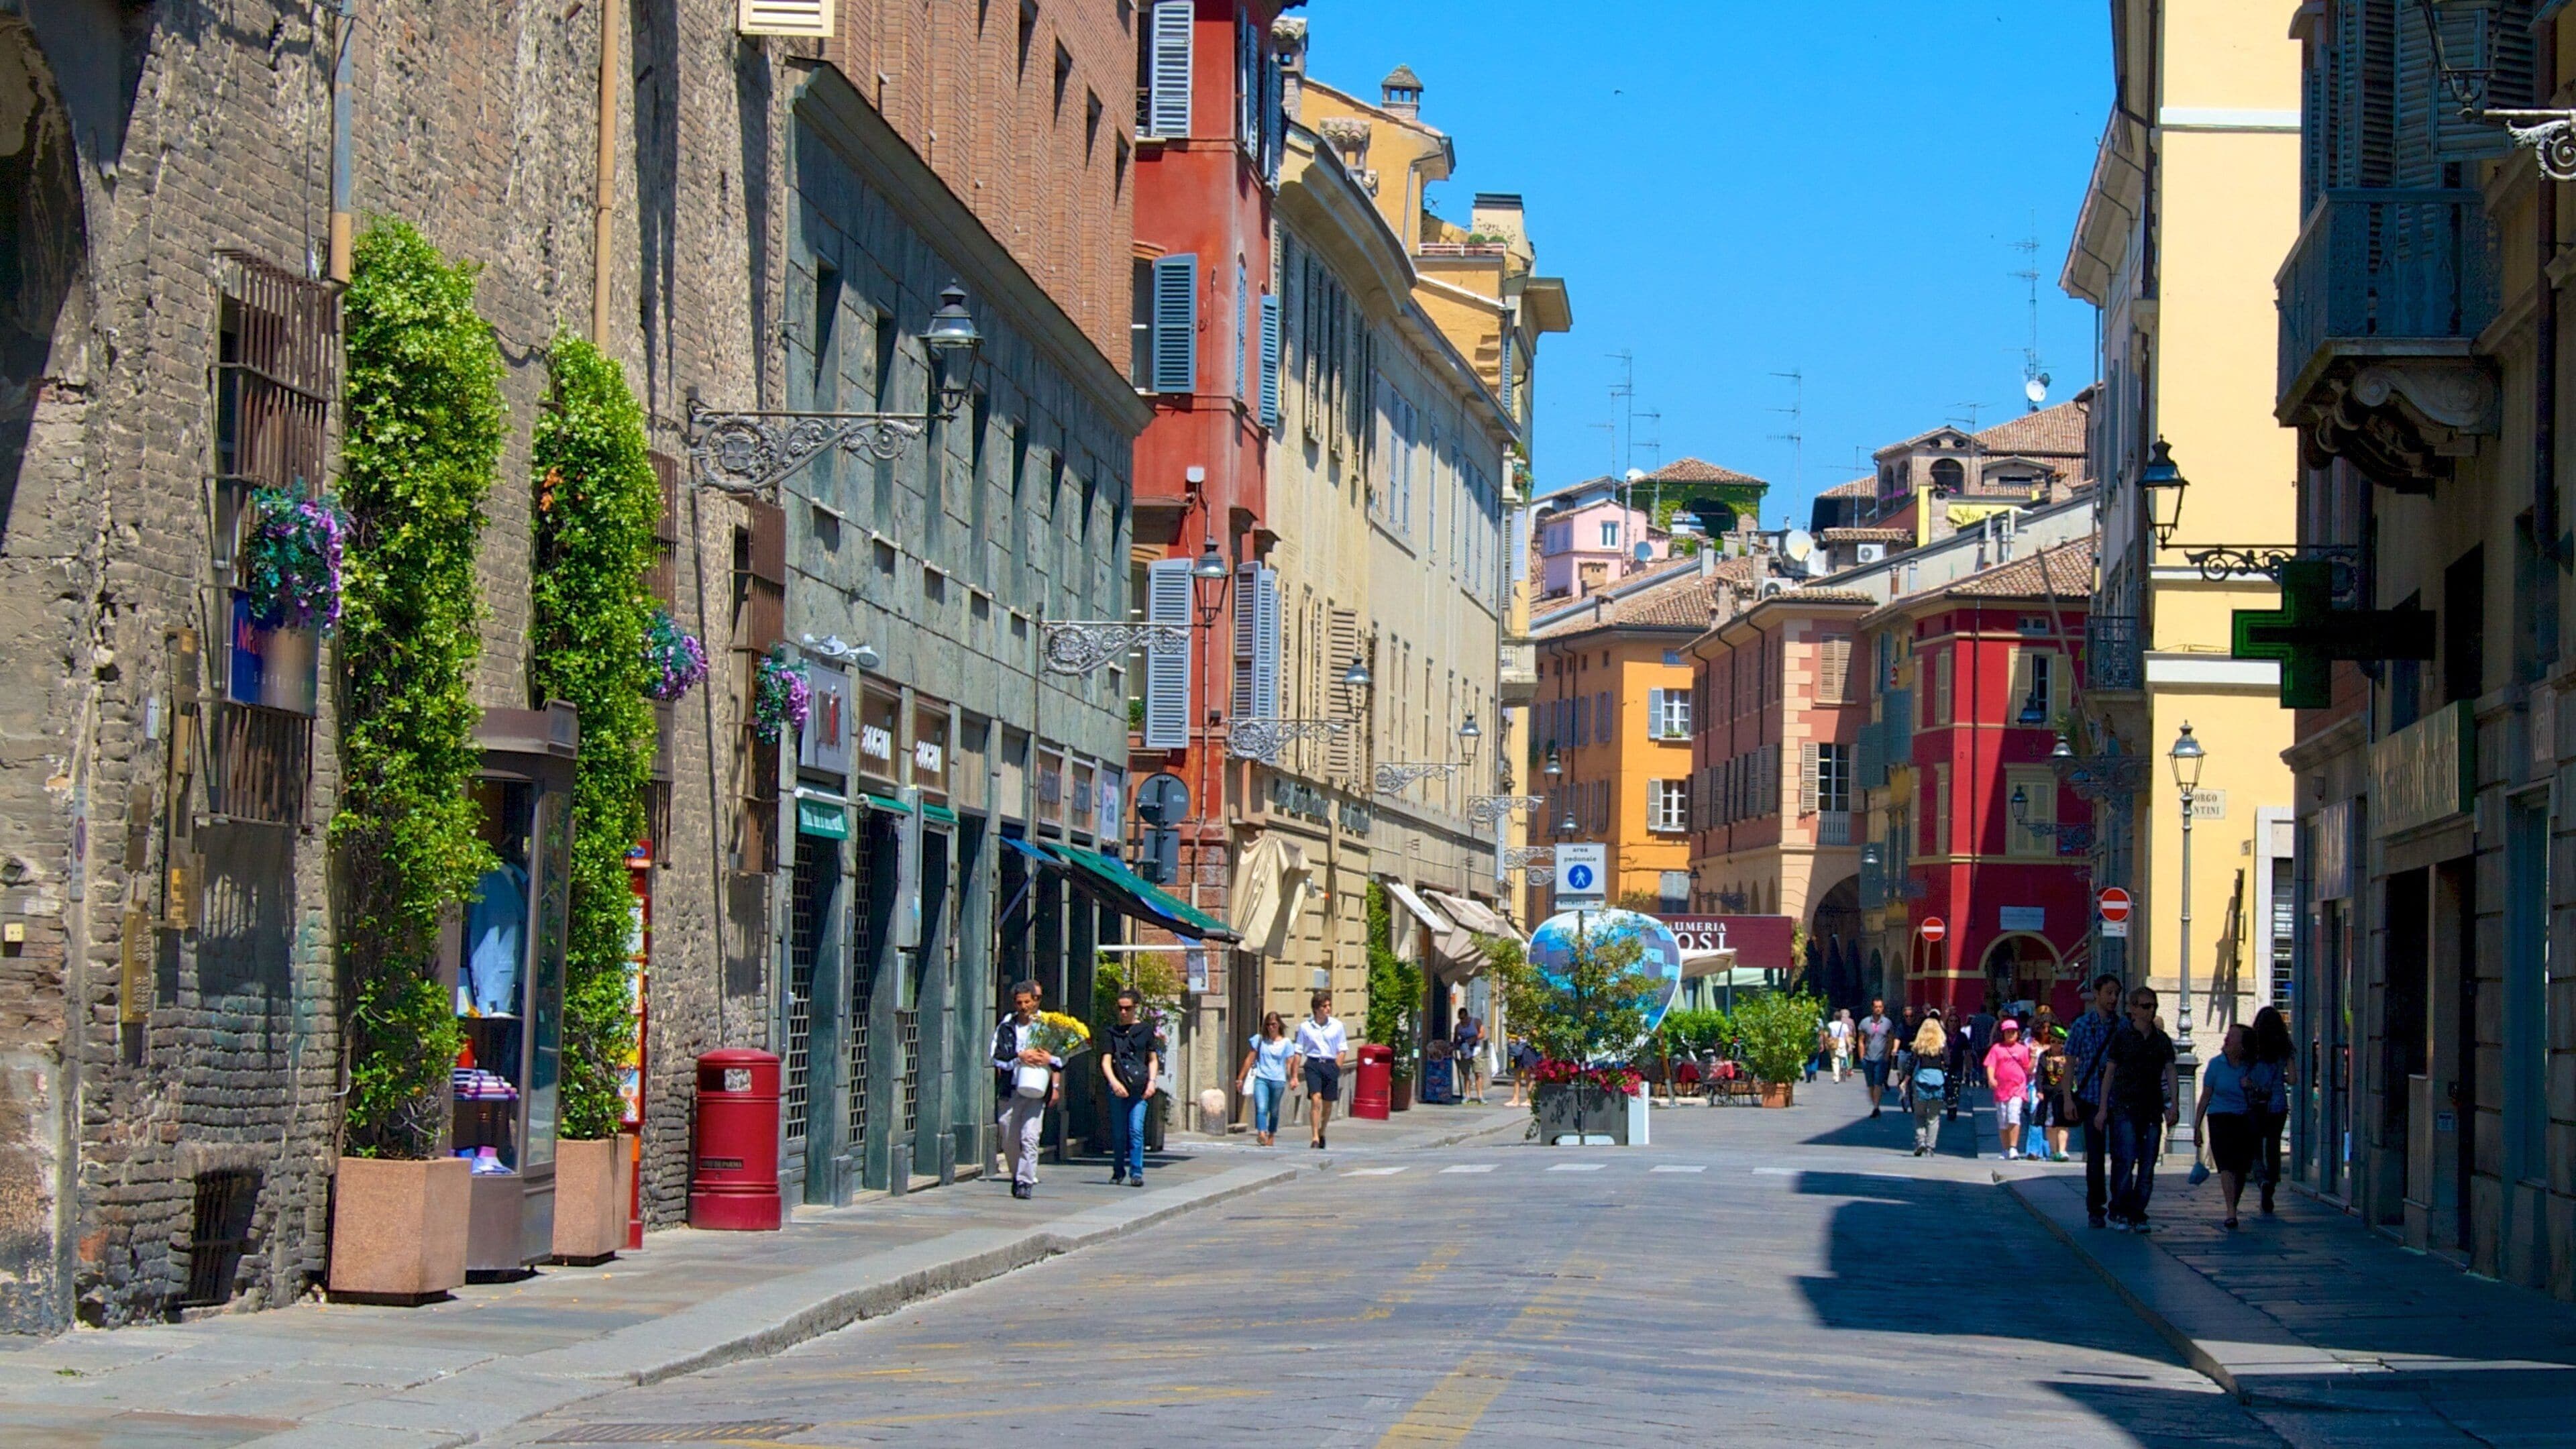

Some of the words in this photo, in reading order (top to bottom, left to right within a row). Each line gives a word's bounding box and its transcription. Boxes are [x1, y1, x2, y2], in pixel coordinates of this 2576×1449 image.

[2194, 806, 2219, 814] NTINI
[1668, 921, 1727, 932] LUMERIA
[1676, 932, 1726, 951] OSI
